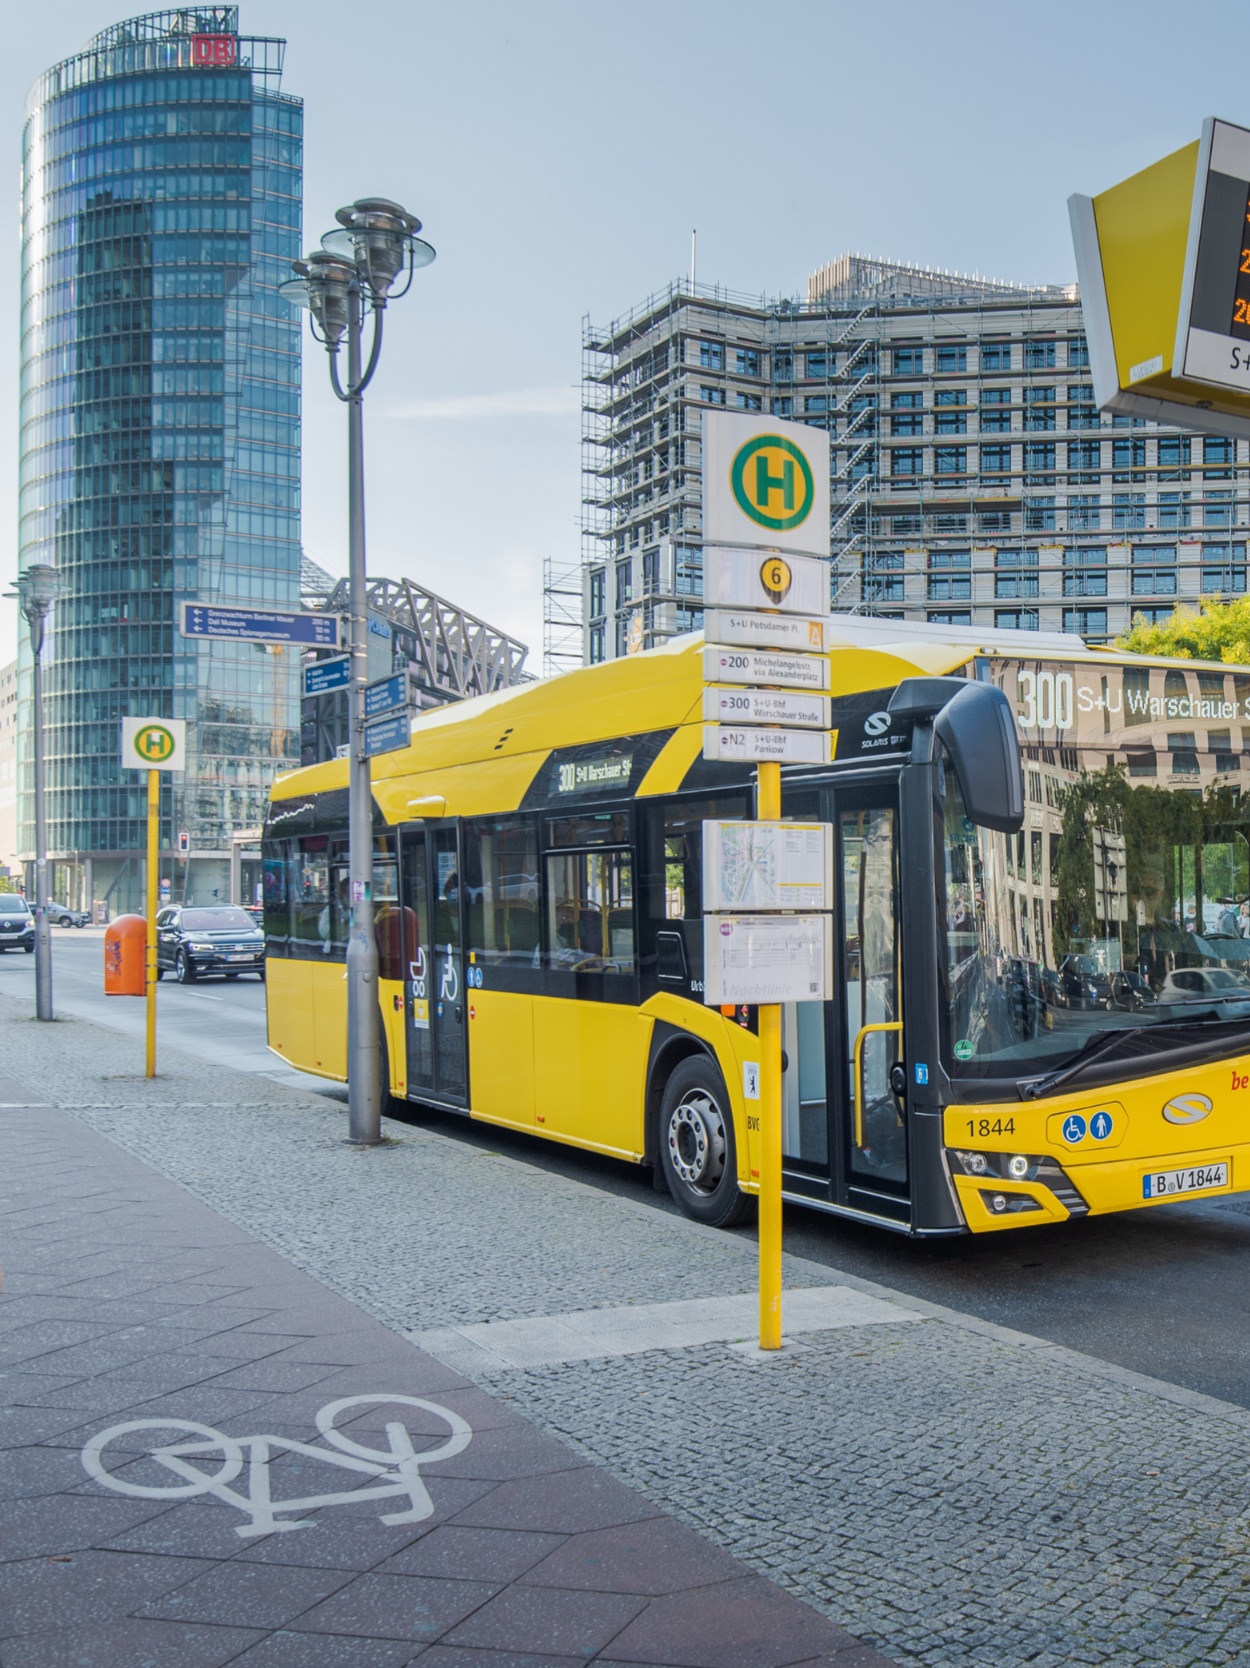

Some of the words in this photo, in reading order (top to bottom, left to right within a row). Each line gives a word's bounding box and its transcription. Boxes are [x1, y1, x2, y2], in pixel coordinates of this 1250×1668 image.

[197, 39, 229, 61] DB
[756, 455, 795, 511] H
[771, 567, 781, 585] 6
[750, 620, 790, 632] Potsdamer
[791, 623, 800, 634] Pl.
[809, 626, 822, 646] A
[728, 656, 749, 669] 200
[753, 657, 812, 671] Michelangelostr.
[753, 668, 766, 677] via
[767, 669, 819, 682] Alexanderplatz
[728, 696, 750, 710] 300
[1017, 670, 1074, 730] 300
[1077, 686, 1123, 714] S+U
[1127, 689, 1239, 720] Warschauer
[753, 708, 797, 720] Warschauer
[797, 710, 819, 722] Straße
[145, 735, 164, 754] H
[729, 733, 745, 746] N2
[861, 737, 889, 749] SOLARIS
[754, 744, 784, 754] Pankow
[558, 763, 576, 792] 300
[588, 762, 622, 781] Warschauer
[729, 981, 792, 997] Nachtlinie
[1231, 1071, 1249, 1091] be
[965, 1117, 1016, 1138] 1844
[1157, 1175, 1166, 1193] B
[1176, 1171, 1185, 1190] V
[1187, 1166, 1222, 1189] 1844
